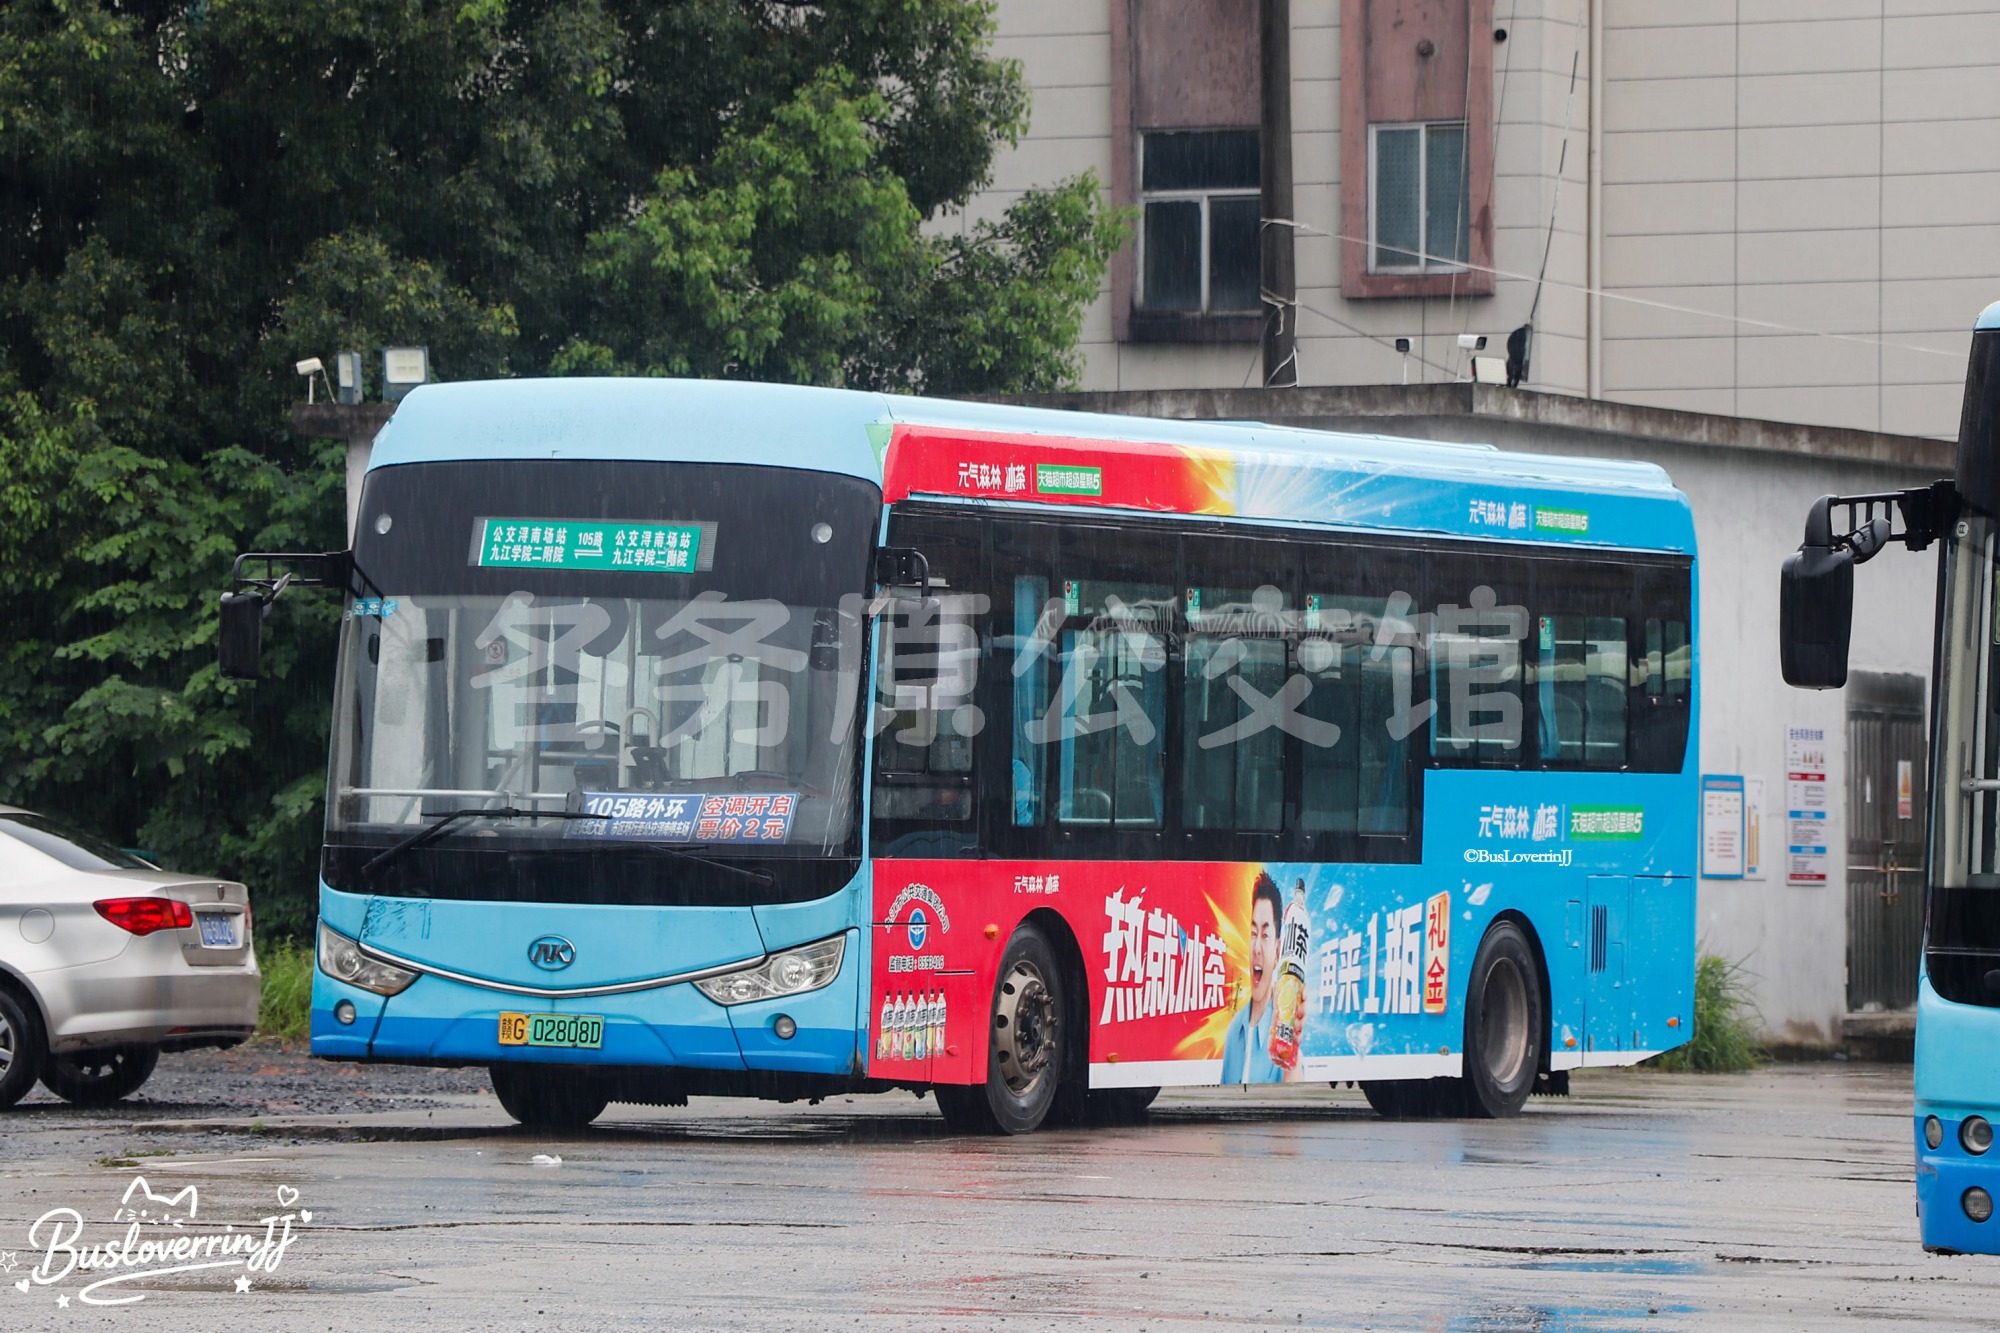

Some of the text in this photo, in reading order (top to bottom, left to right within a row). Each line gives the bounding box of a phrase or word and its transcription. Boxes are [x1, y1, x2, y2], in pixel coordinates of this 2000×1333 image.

[958, 462, 1001, 491] 元气森林
[493, 526, 568, 544] 公交浔南场站
[577, 531, 603, 547] 105路
[614, 530, 692, 549] 公交浔南场站
[489, 544, 565, 563] 九江学院二附院
[611, 548, 687, 568] 九江学院二附院
[586, 797, 687, 819] 105路外环
[702, 796, 791, 817] 空调开启
[696, 818, 785, 839] 票价2元
[1478, 804, 1530, 839] 元气森林
[1319, 903, 1424, 1015] 再来1瓶
[1426, 903, 1447, 1005] 礼金
